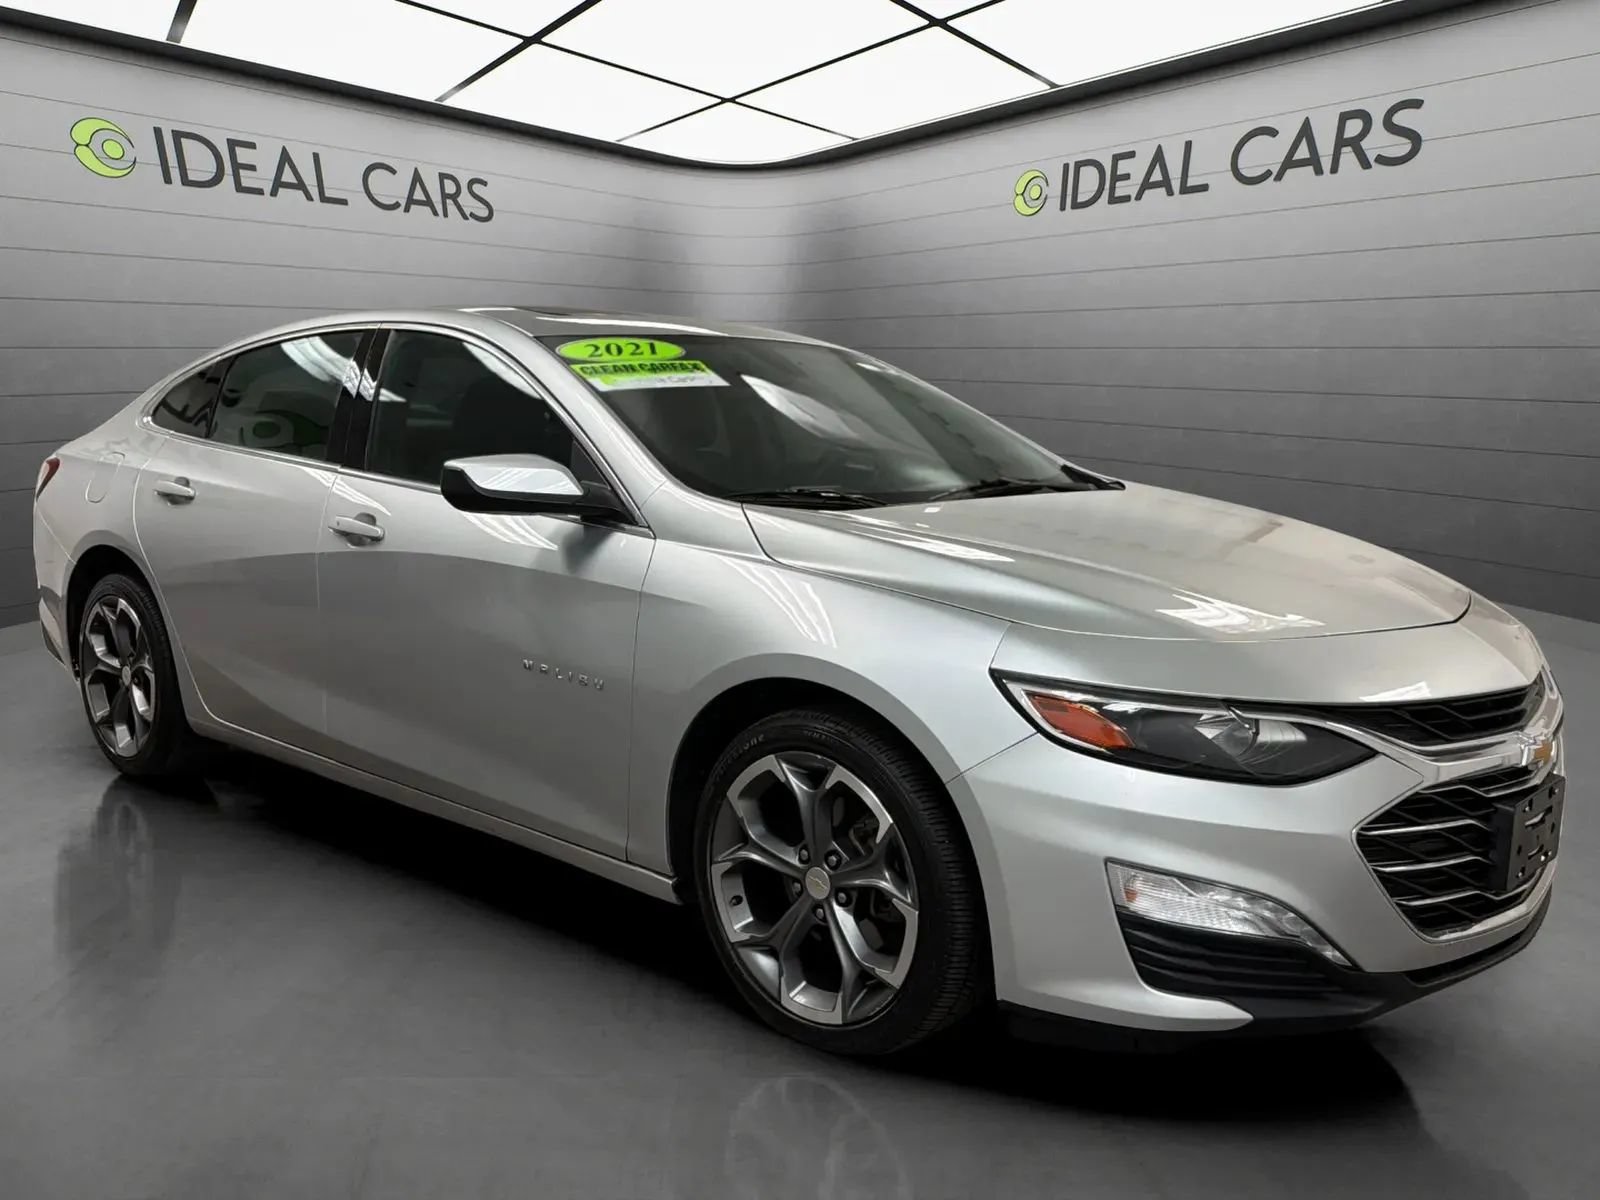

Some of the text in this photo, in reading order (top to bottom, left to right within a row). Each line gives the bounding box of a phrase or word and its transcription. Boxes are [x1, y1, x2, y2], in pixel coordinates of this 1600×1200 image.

[1059, 98, 1425, 212] IDEAL CARS
[153, 126, 495, 223] IDEAL CARS
[583, 342, 659, 358] 2021
[579, 361, 706, 375] CLEAN CARFAX
[522, 659, 605, 691] MALIBU
